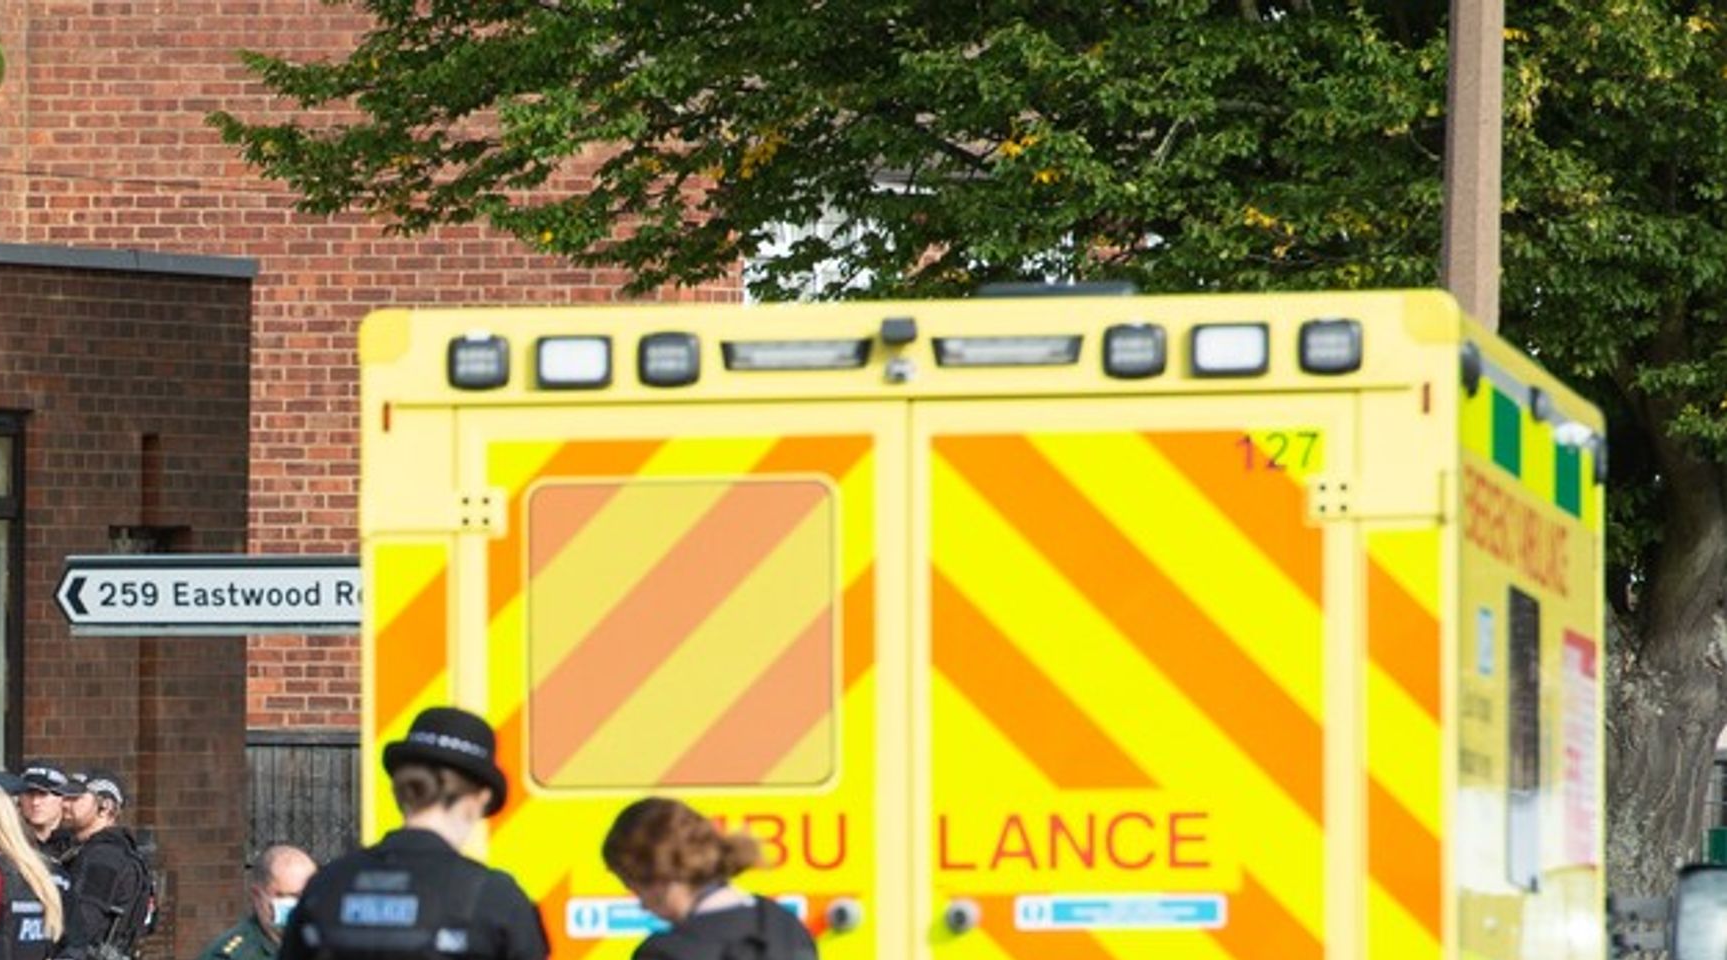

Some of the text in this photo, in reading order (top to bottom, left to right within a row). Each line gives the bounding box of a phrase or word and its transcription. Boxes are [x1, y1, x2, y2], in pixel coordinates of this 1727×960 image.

[1235, 431, 1319, 470] 127
[99, 580, 362, 607] 259 Eastwood R
